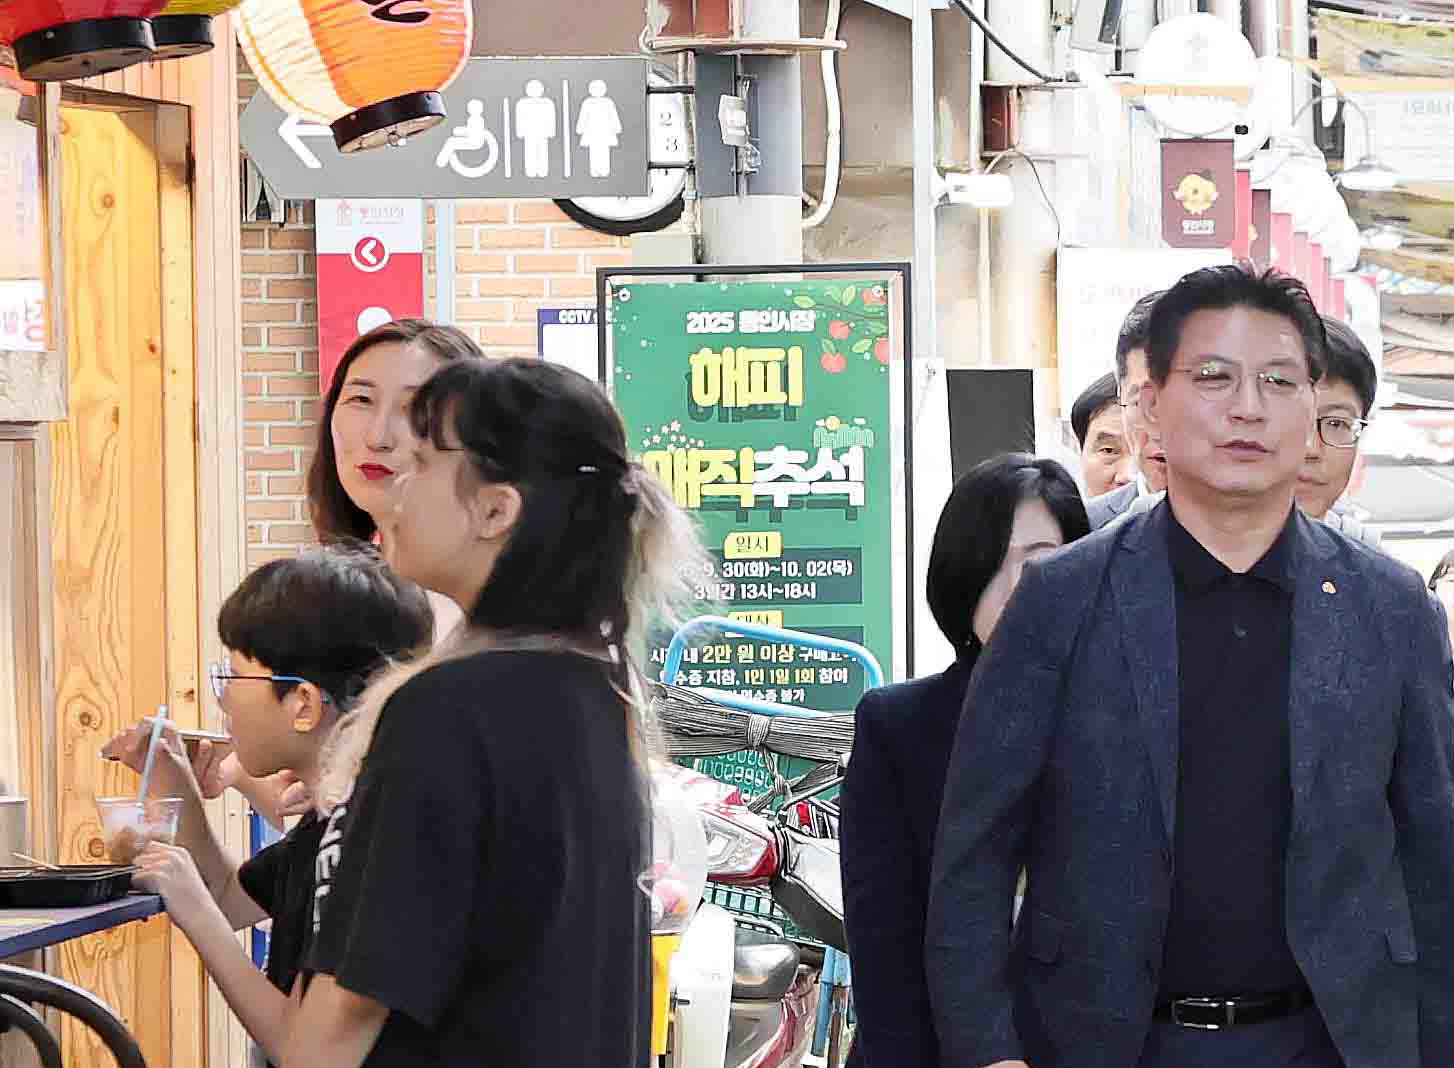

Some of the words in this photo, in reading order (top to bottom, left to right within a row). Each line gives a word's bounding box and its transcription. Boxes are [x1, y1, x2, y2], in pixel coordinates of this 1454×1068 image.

[558, 309, 593, 324] CCTV
[686, 311, 736, 334] 2025
[688, 345, 804, 409] 해피
[642, 444, 865, 508] 매직추석
[735, 534, 770, 553] 일시
[740, 581, 817, 600] 13시~18시
[702, 644, 733, 664] 2만
[737, 643, 755, 664] 원
[759, 643, 796, 664] 이상
